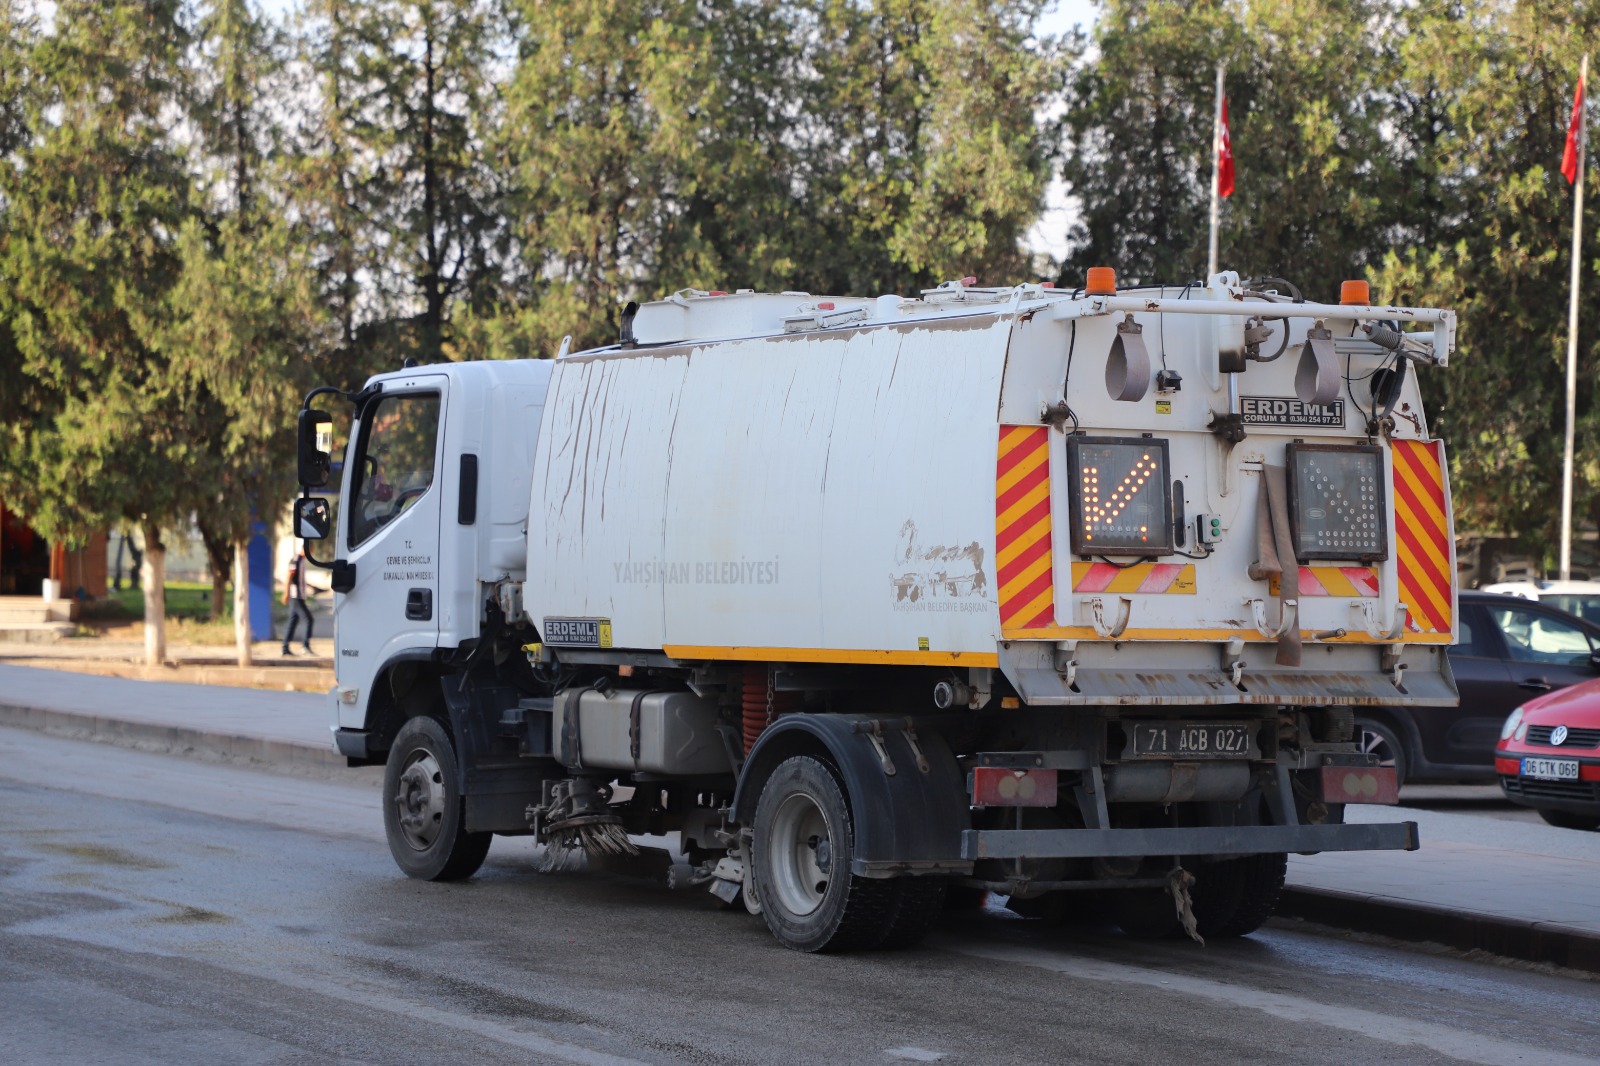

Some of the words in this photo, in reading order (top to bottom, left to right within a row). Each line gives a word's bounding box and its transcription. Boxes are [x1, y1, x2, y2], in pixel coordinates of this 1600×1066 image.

[1243, 414, 1277, 423] ÇORUM
[1308, 416, 1321, 424] 254
[613, 555, 690, 589] YAHŞİHAN
[695, 554, 780, 585] BELEDİYESİ
[927, 600, 958, 612] BELEDİYE
[1148, 729, 1167, 750] 71
[1179, 729, 1208, 750] ACB
[1215, 729, 1244, 750] 027
[1526, 761, 1537, 773] 06
[1540, 762, 1556, 775] CTK
[1558, 763, 1577, 777] 068
